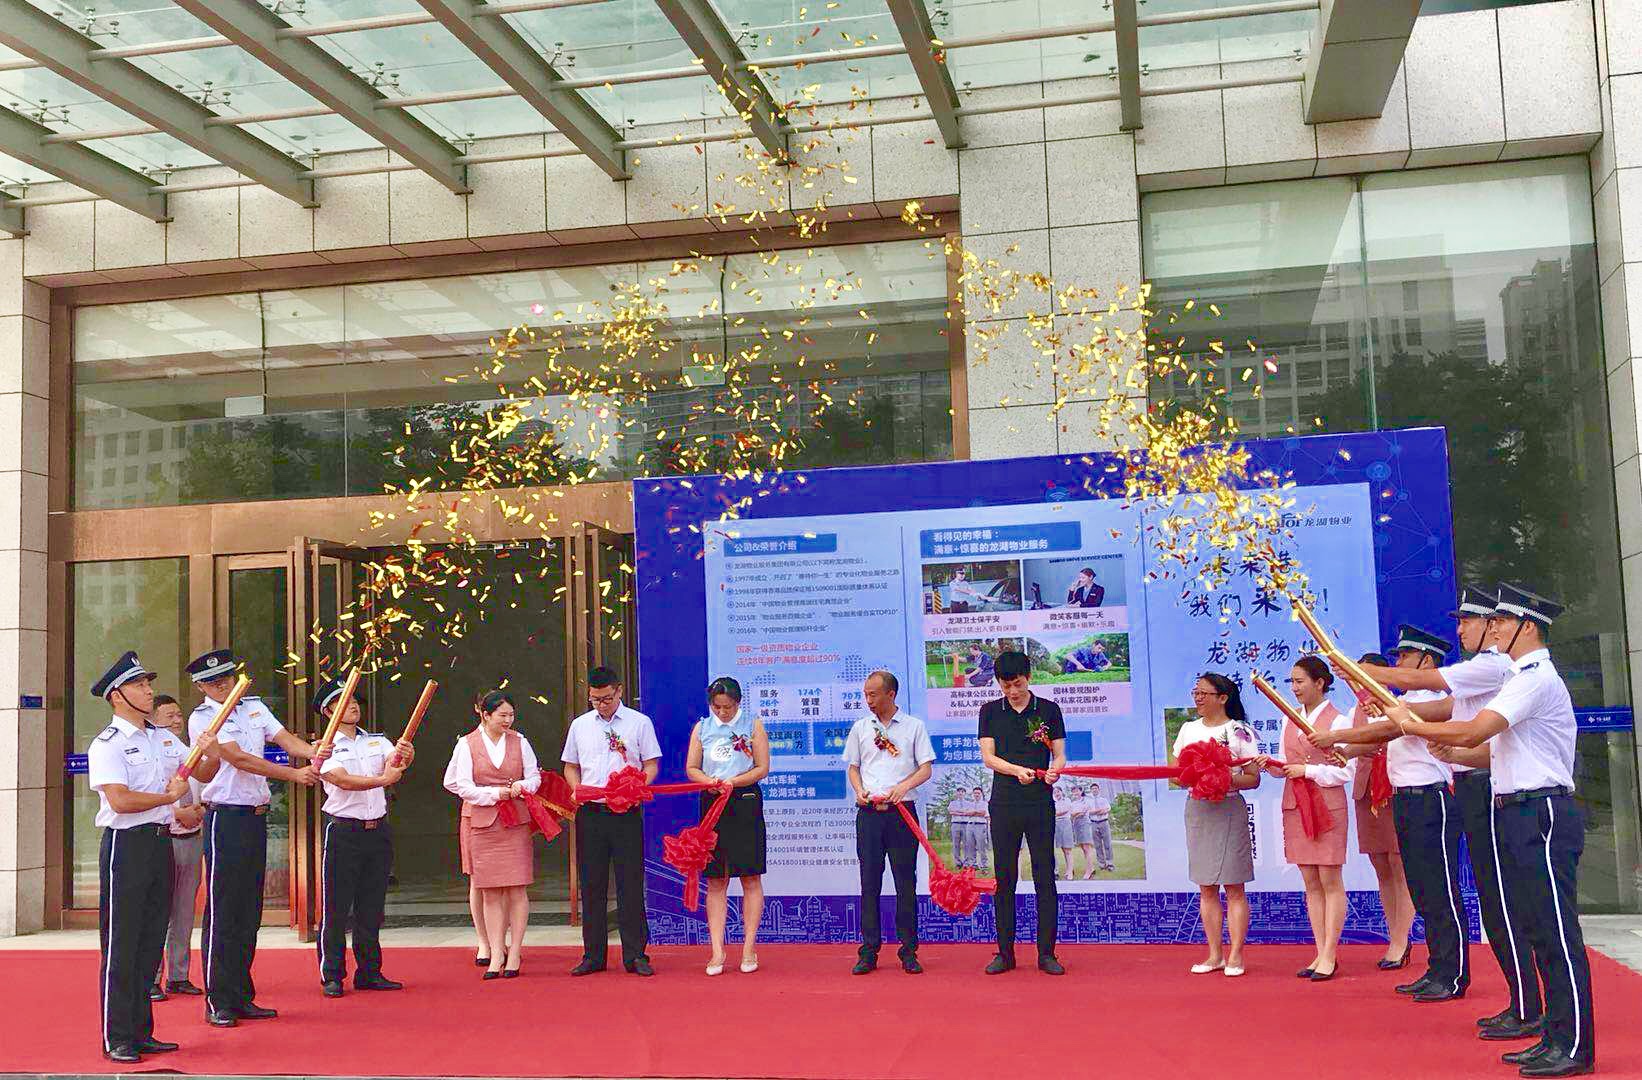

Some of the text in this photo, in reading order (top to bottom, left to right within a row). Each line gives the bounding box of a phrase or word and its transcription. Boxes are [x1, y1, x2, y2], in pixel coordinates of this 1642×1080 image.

[1304, 517, 1353, 528] 龙湖物业
[934, 539, 1049, 555] 满意+惊喜的龙湖物业服务
[947, 615, 1000, 625] 龙湖卫士保平安
[1050, 611, 1104, 621] 微笑客服每一天
[760, 689, 779, 698] 服务
[798, 688, 822, 697] 174个
[841, 691, 862, 699] 70万
[801, 698, 820, 706] 管理
[843, 701, 862, 711] 业主
[760, 708, 779, 717] 城市
[801, 707, 820, 716] 项目
